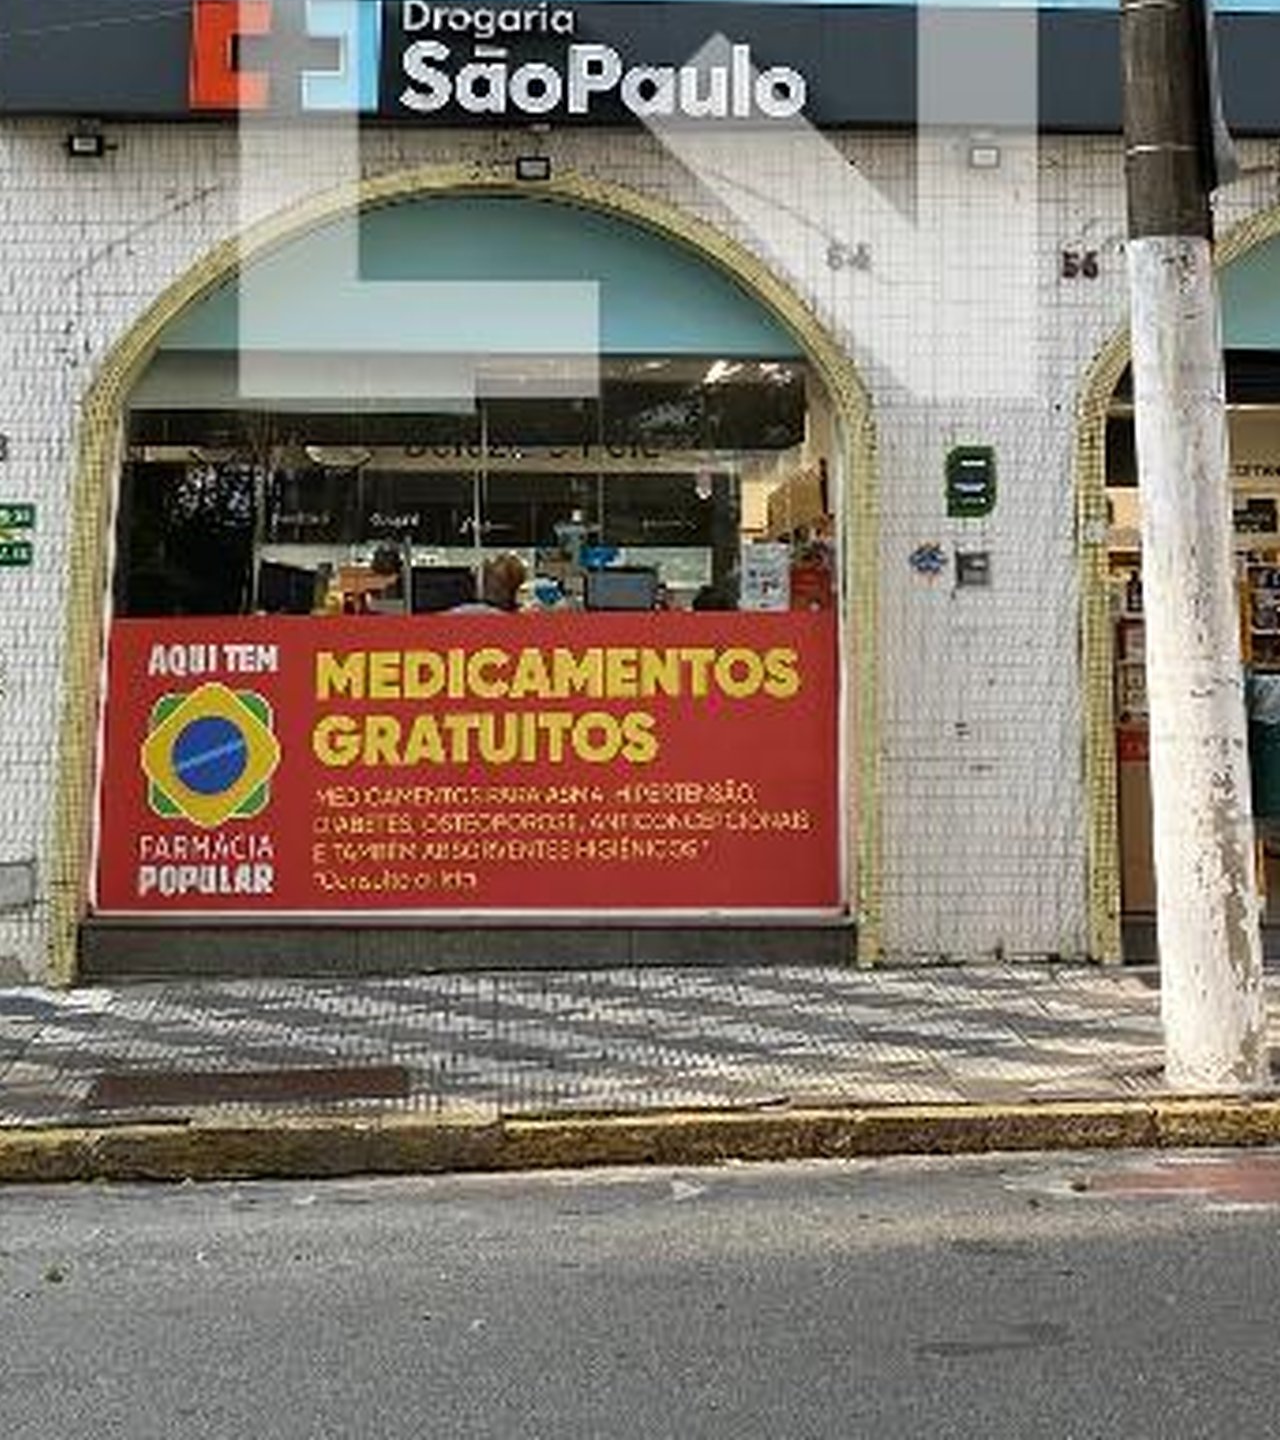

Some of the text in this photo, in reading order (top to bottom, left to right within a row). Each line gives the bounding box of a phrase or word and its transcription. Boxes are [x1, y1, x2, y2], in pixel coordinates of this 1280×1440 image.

[402, 0, 575, 38] Drogaria
[148, 643, 279, 677] AQUI TEM
[315, 647, 801, 700] MEDICAMENTOS
[311, 711, 660, 767] GRATUITOS
[139, 833, 274, 861] FARMÁCIA
[138, 863, 274, 896] POPULAR
